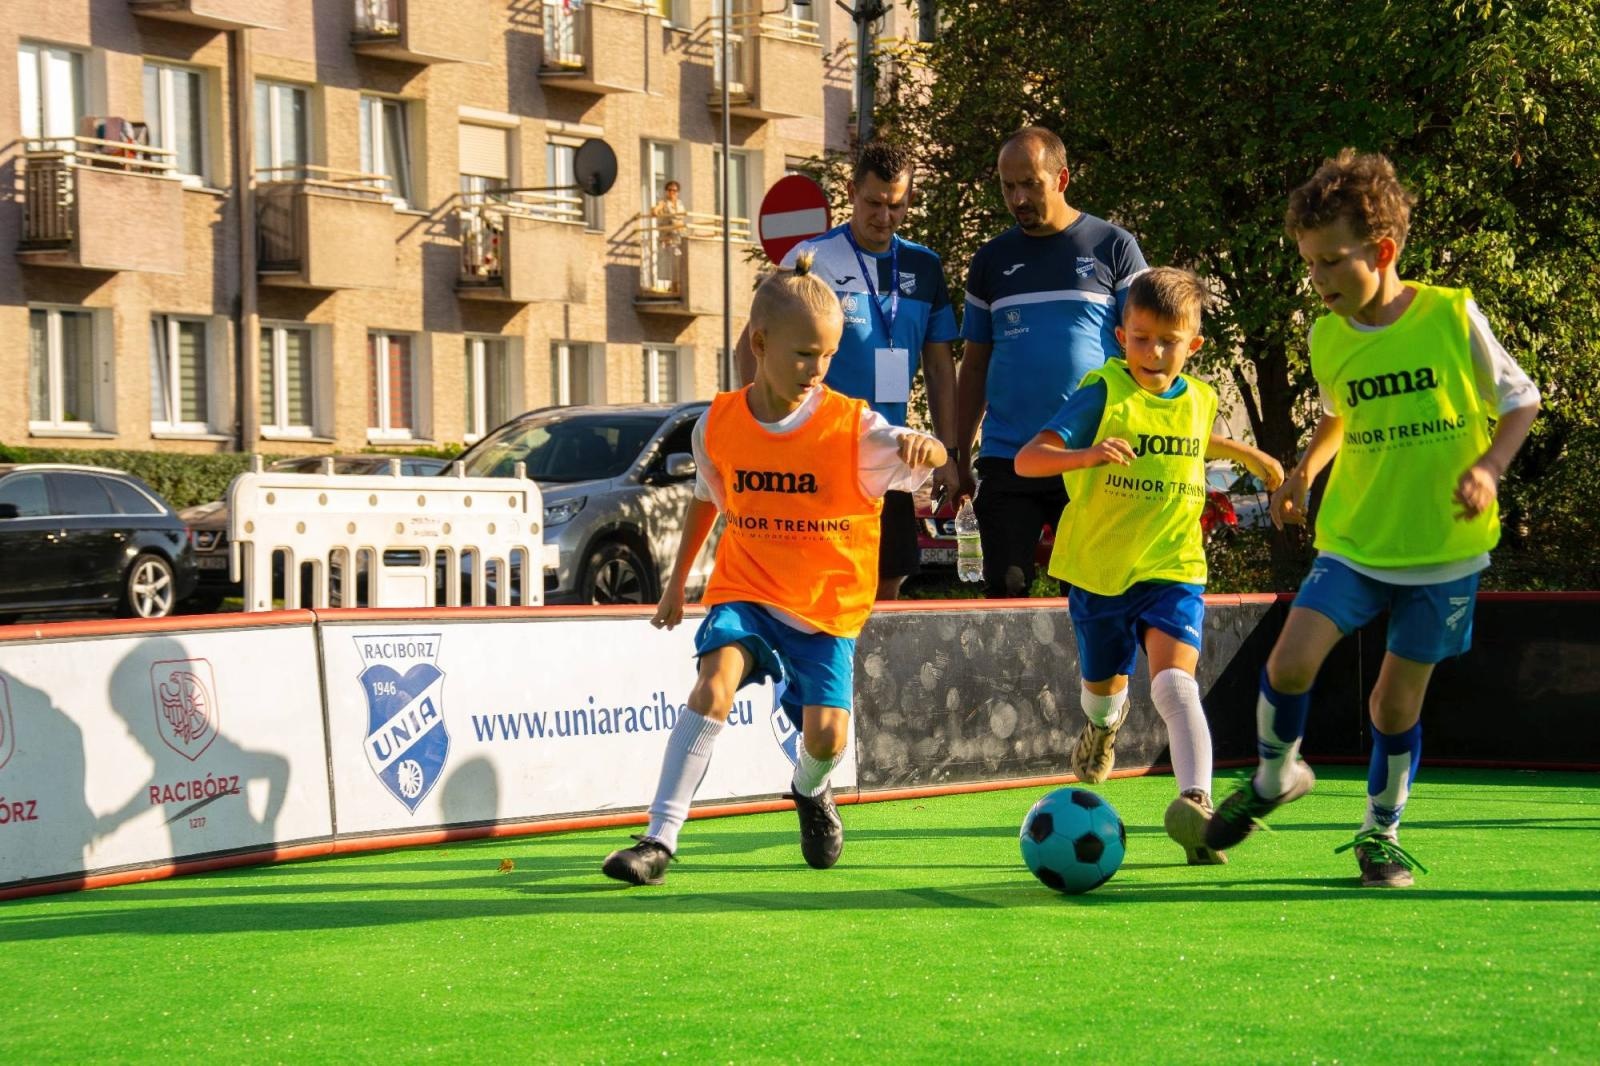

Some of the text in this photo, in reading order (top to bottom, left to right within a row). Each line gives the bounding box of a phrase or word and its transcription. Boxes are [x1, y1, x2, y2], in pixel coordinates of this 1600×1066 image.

[1388, 415, 1466, 441] TRENING
[1105, 474, 1164, 493] JUNIOR
[773, 518, 851, 532] TRENING
[364, 637, 435, 659] RACIBÓRZ
[372, 681, 397, 696] 1946
[372, 696, 438, 761] UNIA
[149, 772, 240, 805] RACIBÓRZ
